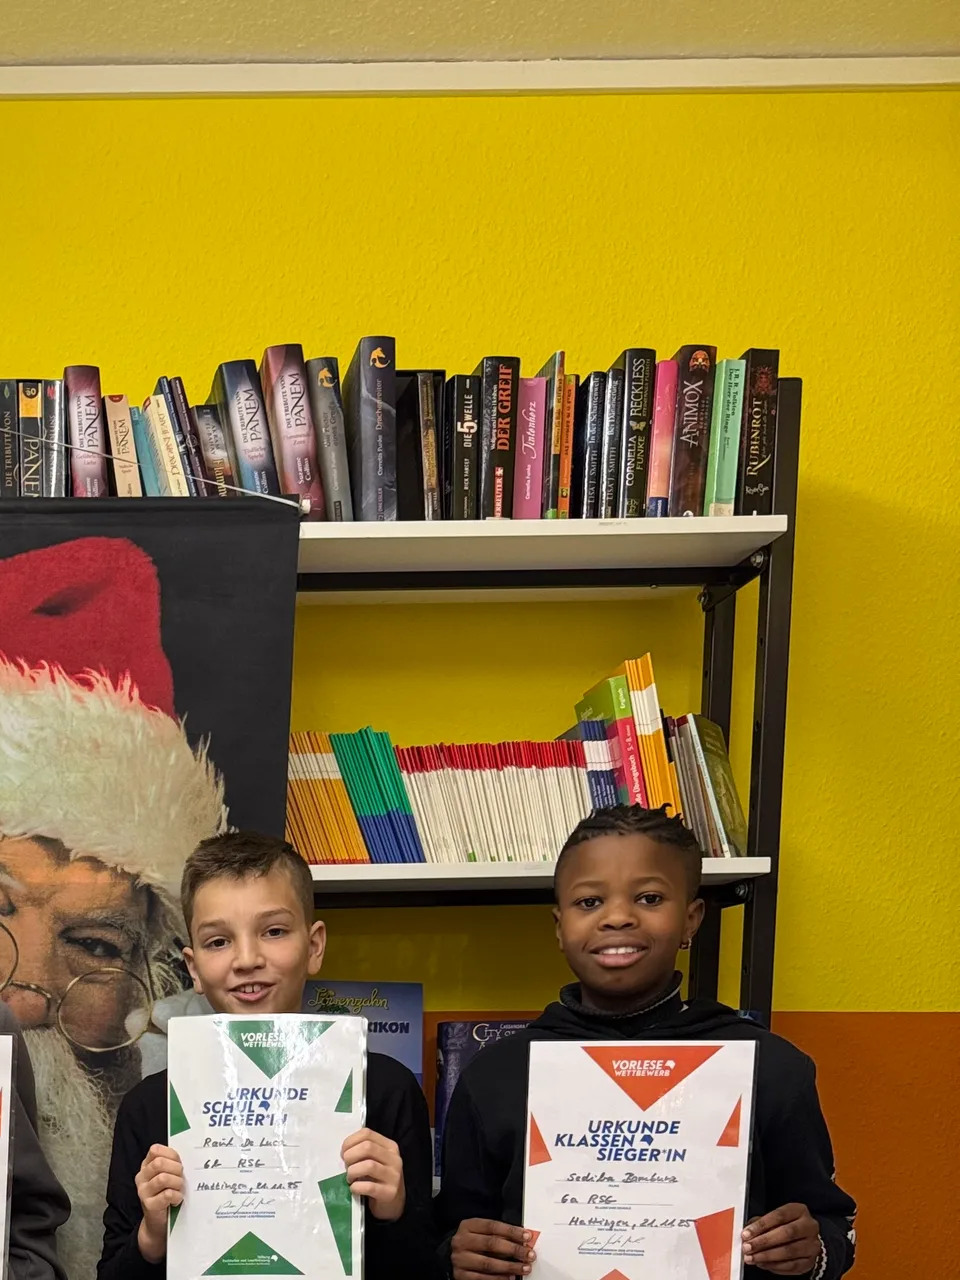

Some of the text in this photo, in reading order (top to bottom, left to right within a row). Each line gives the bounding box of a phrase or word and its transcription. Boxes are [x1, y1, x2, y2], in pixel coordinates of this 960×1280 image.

[282, 390, 290, 416] TRIBUTE
[288, 373, 307, 427] PANEM
[375, 379, 383, 430] Drachenreiter
[463, 394, 473, 420] WELLE
[497, 364, 513, 450] DER GREIF
[590, 377, 600, 422] Schattenwelt
[84, 394, 100, 448] PANEM
[238, 406, 247, 431] TRIBUTE
[244, 388, 262, 441] PANEM
[457, 419, 478, 433] 5.
[626, 358, 645, 486] CORNELIA RECKLESS
[680, 380, 703, 448] ANIMOX
[118, 419, 130, 454] PANEM
[463, 434, 472, 448] DIE
[521, 401, 537, 459] Tintenherz
[588, 436, 596, 444] In
[589, 423, 597, 435] der
[746, 398, 771, 476] RUBINROT
[4, 432, 12, 469] TRIBUTE
[590, 450, 598, 476] SMITH
[608, 447, 616, 472] SMITH
[636, 435, 645, 470] FUNKE
[5, 472, 13, 487] DIE
[261, 471, 269, 493] Collins
[296, 457, 304, 484] Suzanne
[304, 458, 312, 481] Collins
[588, 487, 596, 503] LISA
[606, 483, 614, 500] LISA
[617, 688, 626, 709] Englisch
[627, 755, 641, 792] Übungsbuch
[307, 985, 389, 1014] Löwenzahn
[612, 1060, 663, 1070] VORLESE
[615, 1069, 670, 1077] WETTBEWERB
[227, 1088, 309, 1100] URKUNDE
[203, 1101, 255, 1114] SCHUL
[589, 1121, 680, 1134] URKUNDE
[555, 1134, 635, 1147] KLASSEN
[237, 1159, 265, 1168] RSG
[561, 1194, 617, 1204] 6a RSG
